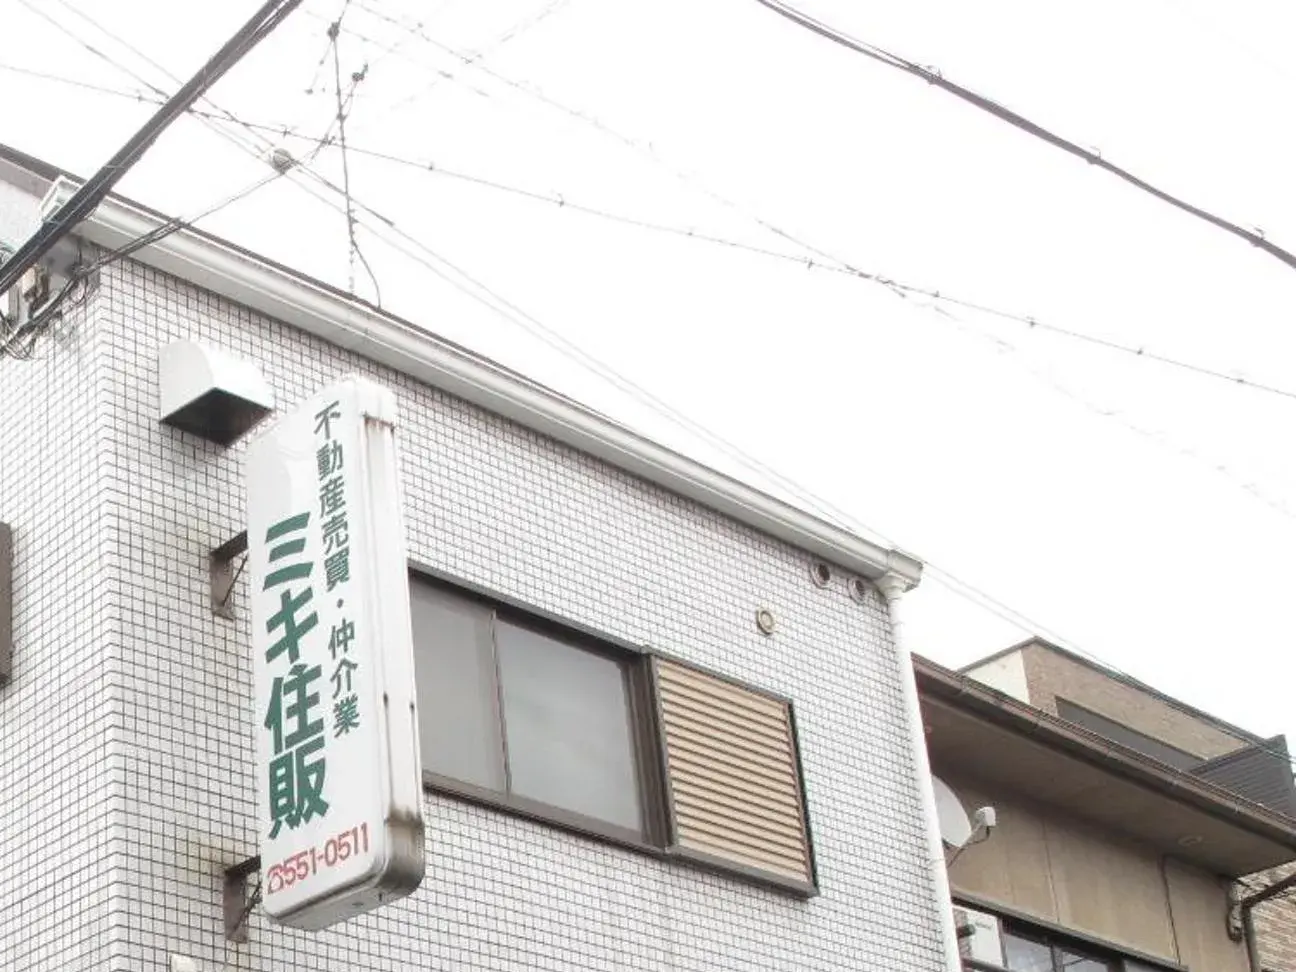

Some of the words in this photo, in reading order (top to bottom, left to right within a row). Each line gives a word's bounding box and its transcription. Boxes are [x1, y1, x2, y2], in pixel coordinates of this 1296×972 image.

[263, 511, 330, 840] ミキ住販
[313, 399, 360, 738] 不動産売買・仲介業
